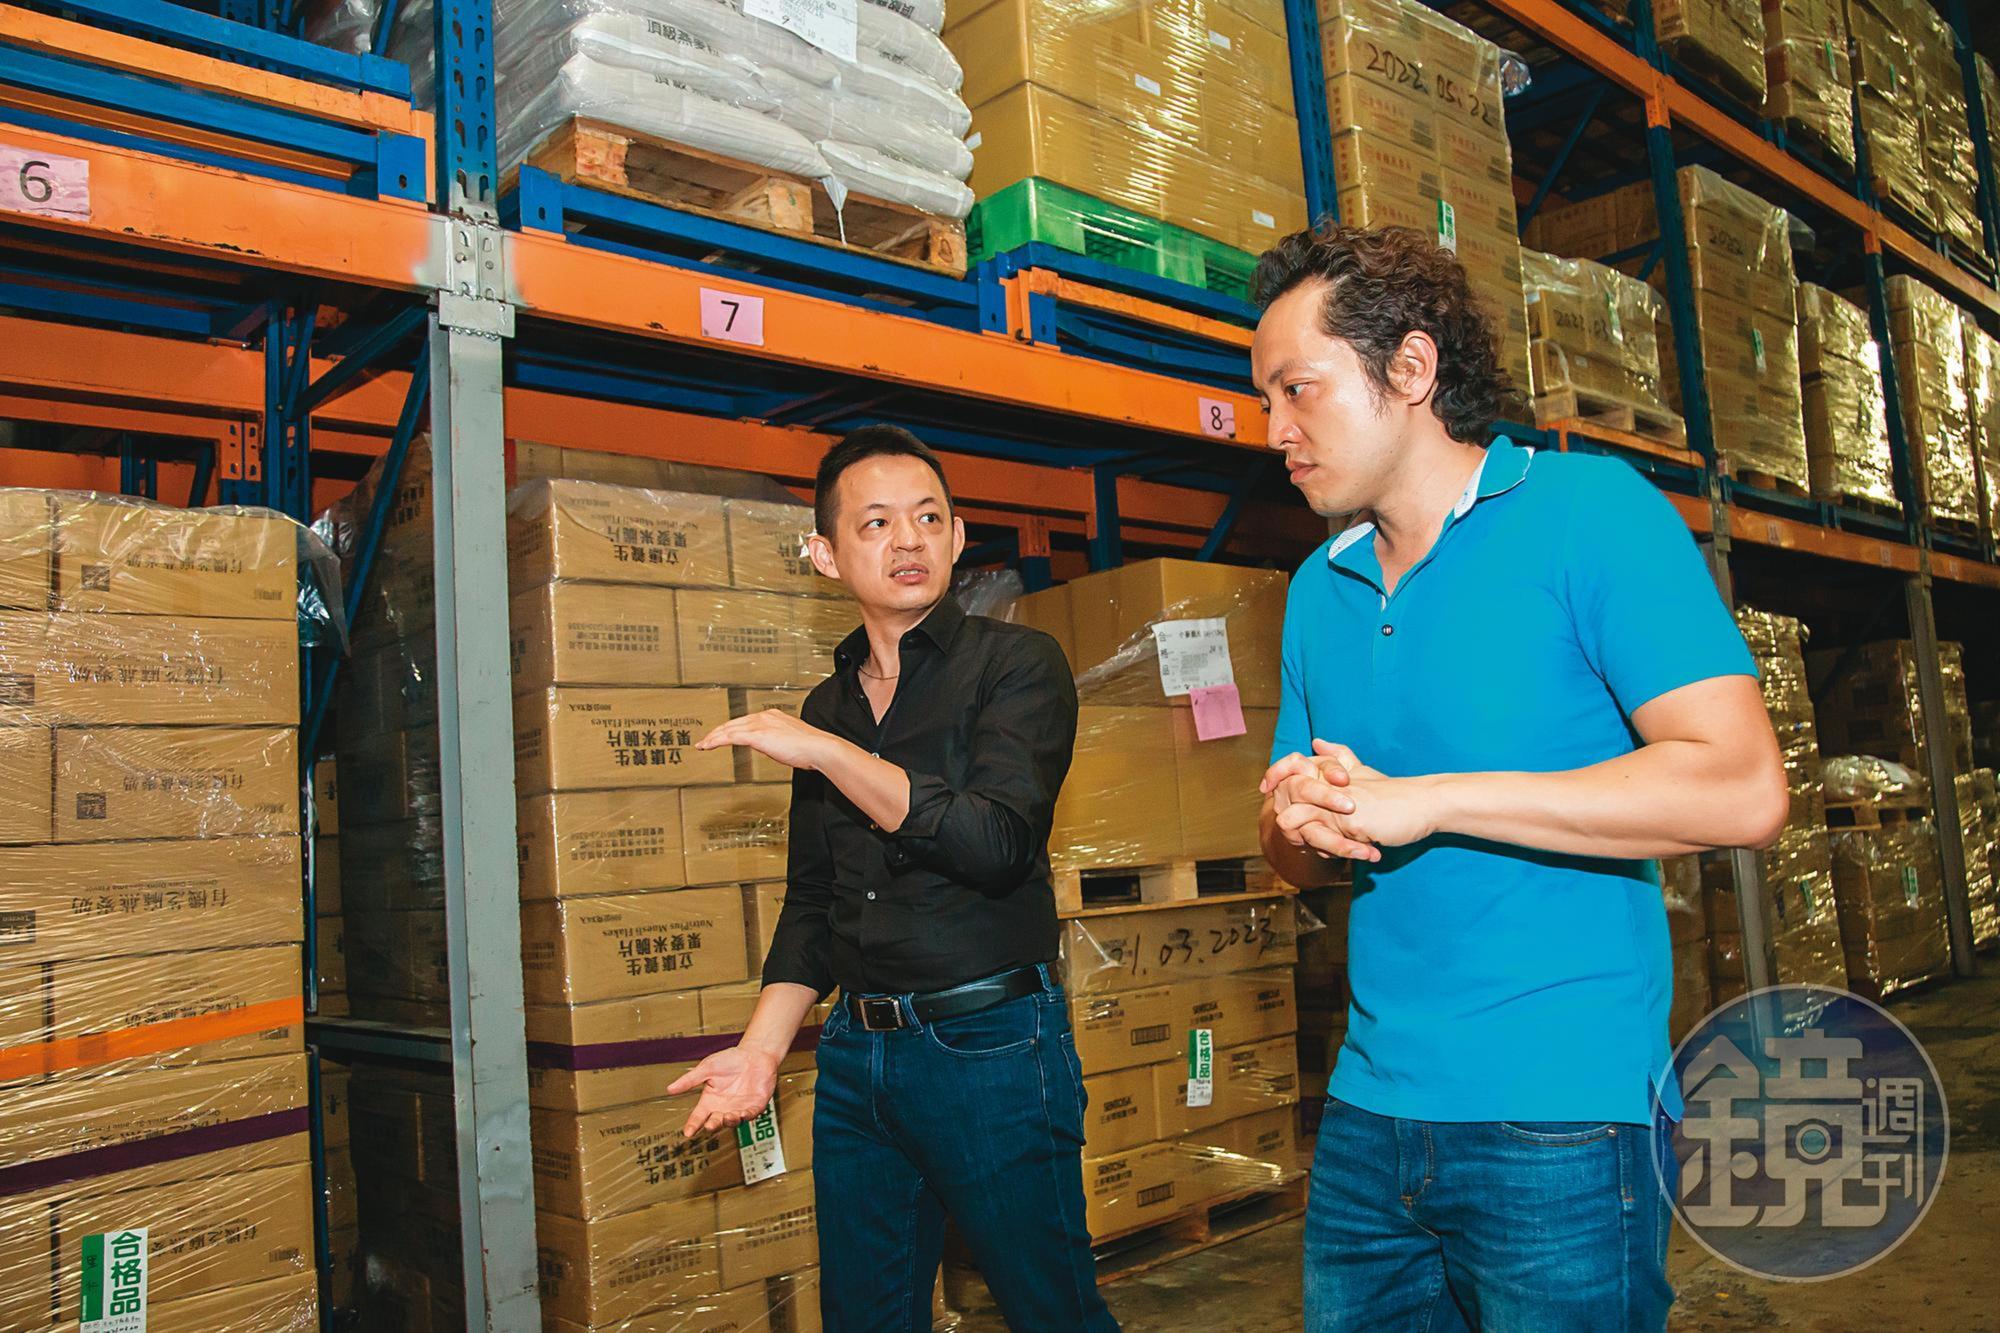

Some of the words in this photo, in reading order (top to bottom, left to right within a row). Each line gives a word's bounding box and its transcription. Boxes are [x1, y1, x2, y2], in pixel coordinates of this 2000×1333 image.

[19, 160, 53, 203] 6
[720, 298, 740, 333] 7
[1210, 405, 1224, 431] 8
[605, 729, 691, 748] 果麥米脆片
[613, 747, 682, 766] 立康養生
[71, 887, 229, 915] 有機芝麻燕麥奶
[602, 927, 634, 939] Flakes
[617, 932, 703, 957] 果麥米脆片
[625, 952, 694, 977] 立康養生
[109, 1231, 142, 1317] 合格品
